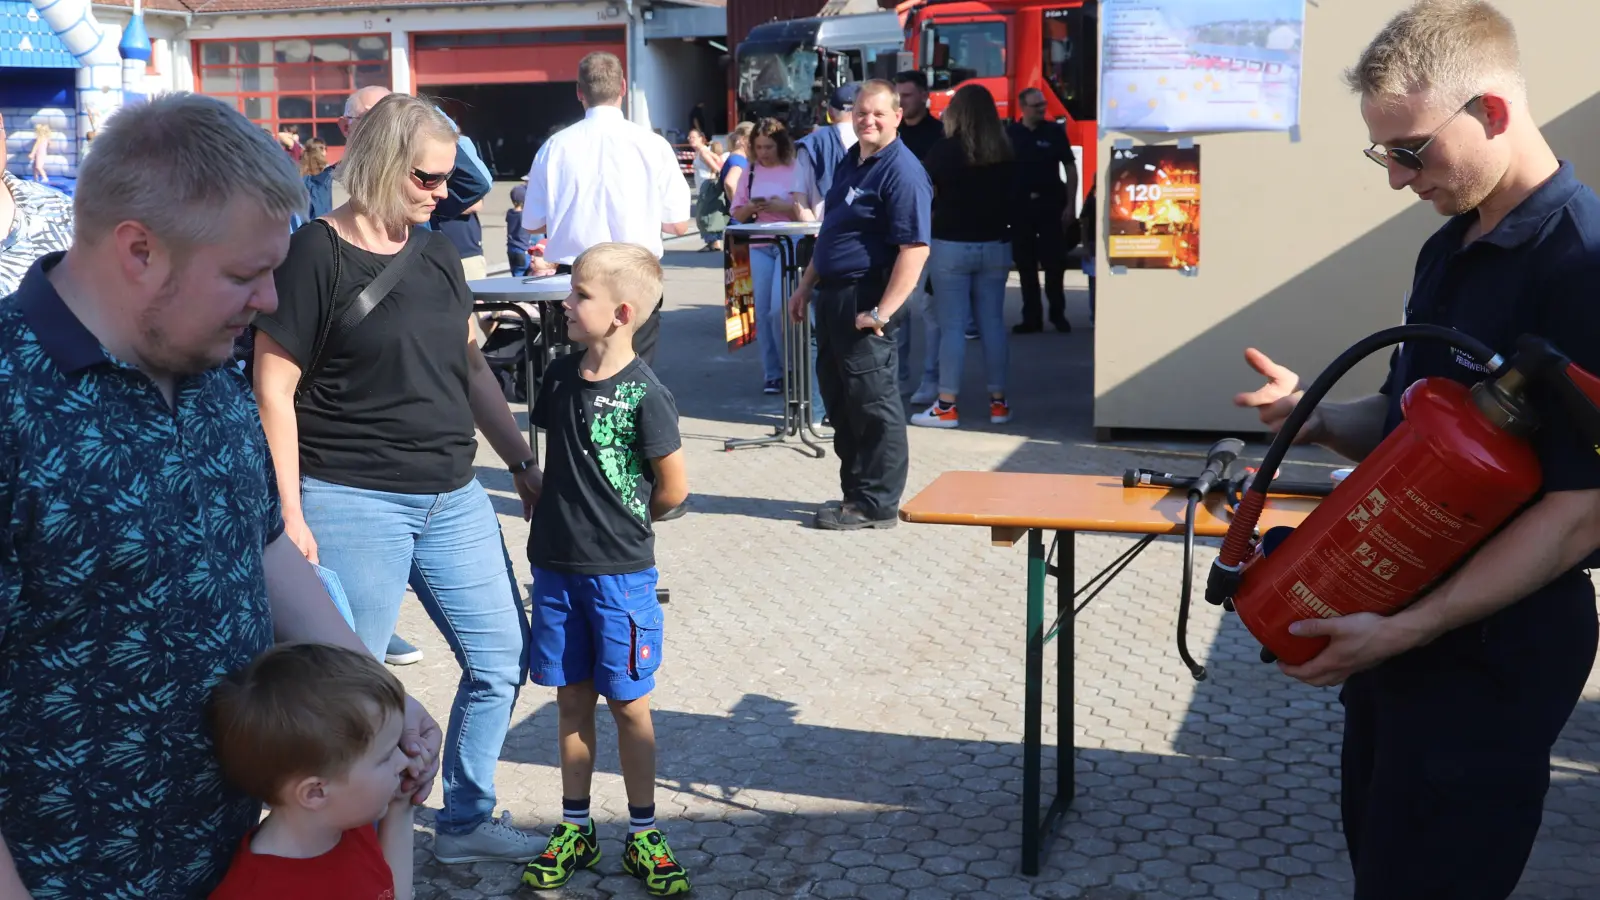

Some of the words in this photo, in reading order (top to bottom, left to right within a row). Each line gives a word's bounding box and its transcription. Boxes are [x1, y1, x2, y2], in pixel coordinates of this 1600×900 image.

[364, 20, 373, 30] 13
[1126, 184, 1162, 201] 120
[1367, 549, 1377, 560] A
[1389, 563, 1400, 574] B
